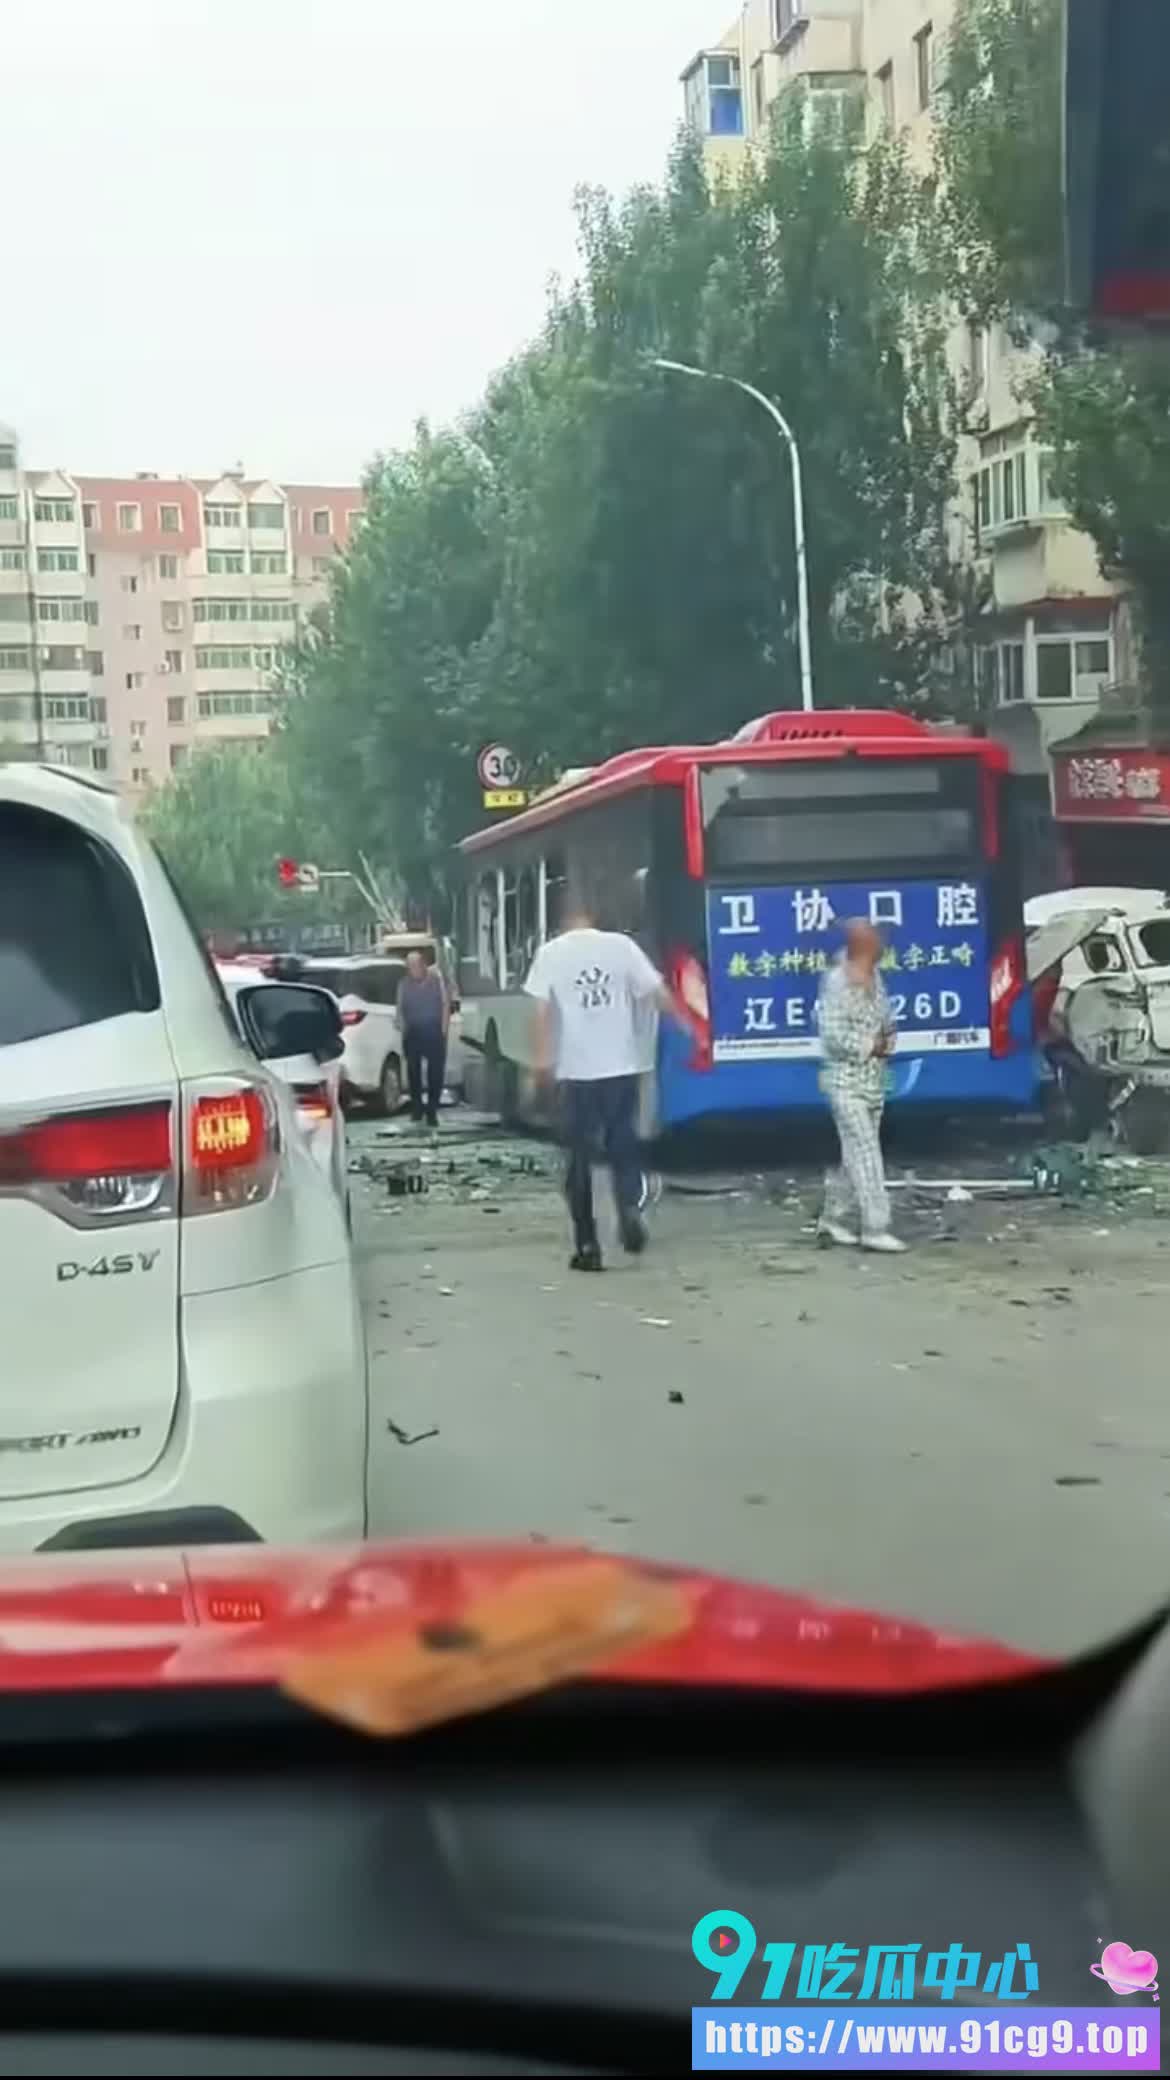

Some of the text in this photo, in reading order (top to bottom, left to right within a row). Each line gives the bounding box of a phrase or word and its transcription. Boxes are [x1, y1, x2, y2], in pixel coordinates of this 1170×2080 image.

[488, 755, 517, 778] 30
[719, 883, 979, 935] 卫协口腔
